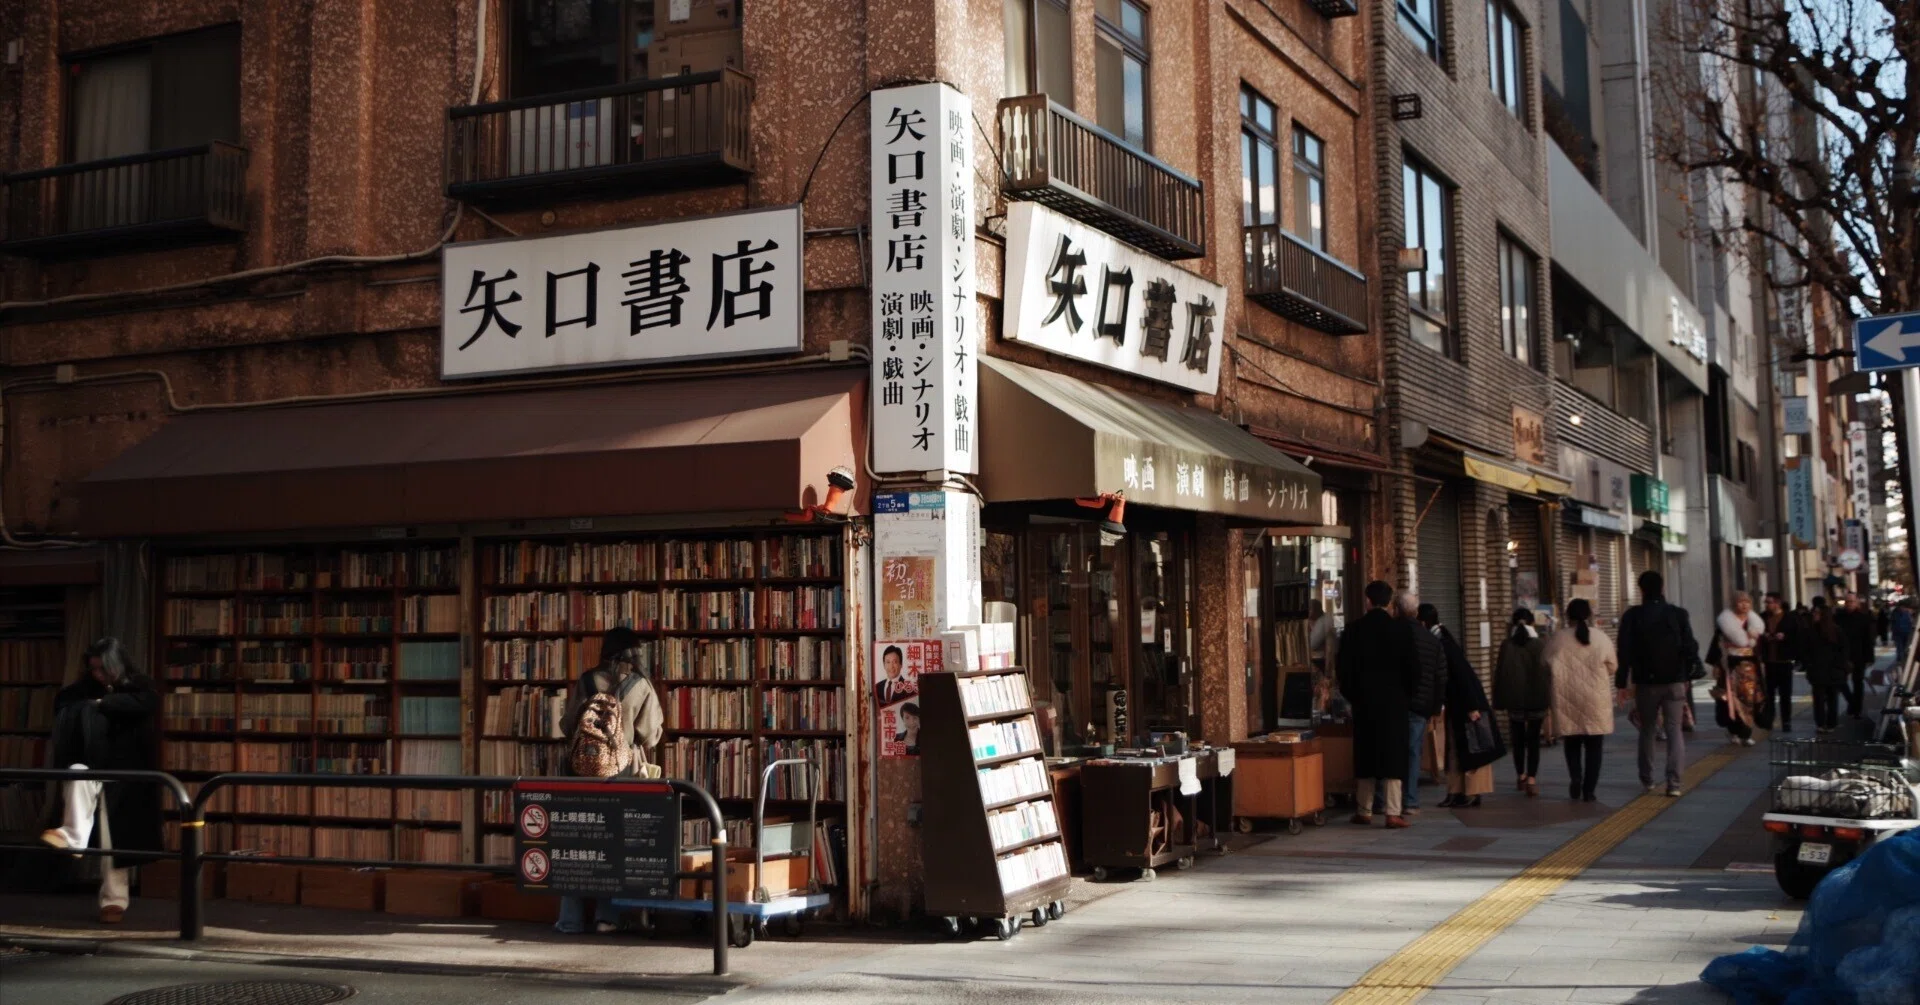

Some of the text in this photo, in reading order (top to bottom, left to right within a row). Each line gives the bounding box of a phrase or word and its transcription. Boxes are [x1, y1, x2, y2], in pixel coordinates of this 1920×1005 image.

[885, 107, 927, 272] 矢口書店
[459, 239, 779, 351] 矢口書店
[880, 292, 904, 406] 演劇・戯曲
[1041, 233, 1217, 374] 矢口書店
[910, 290, 935, 451] 映画・シナリオ
[1124, 453, 1308, 509] 映画 演劇 戯曲 シナリオ
[550, 811, 606, 824] 路上喫煙禁止
